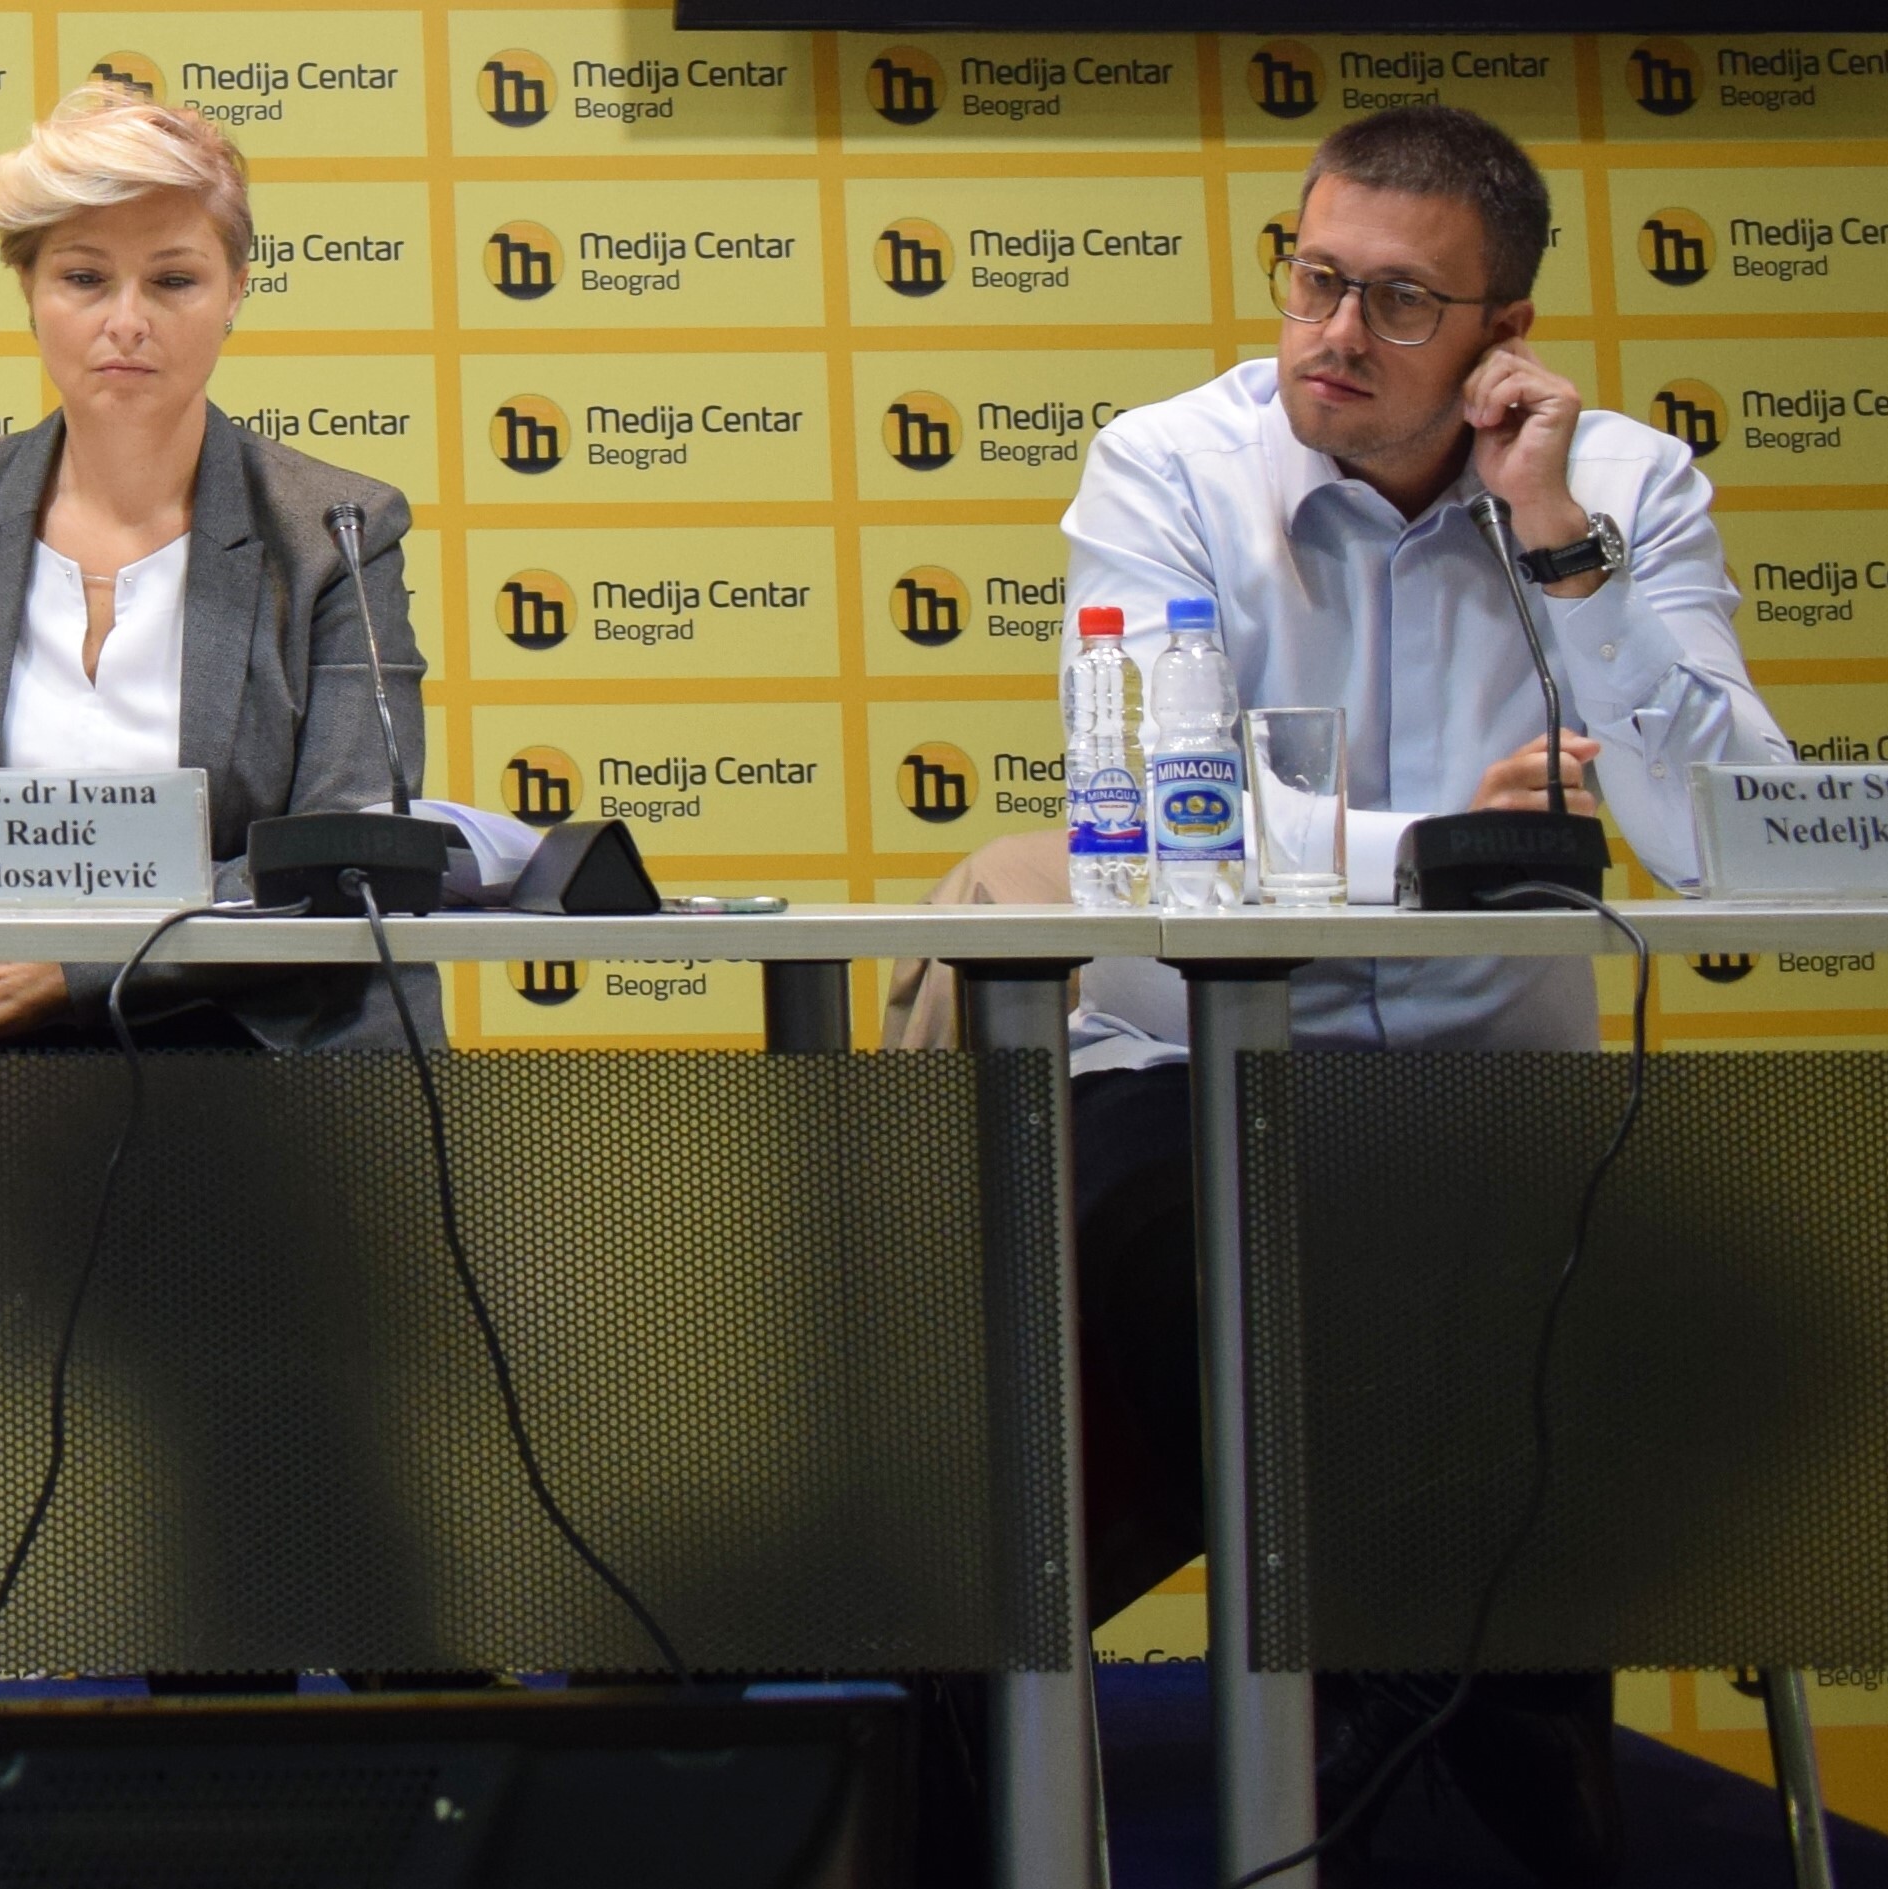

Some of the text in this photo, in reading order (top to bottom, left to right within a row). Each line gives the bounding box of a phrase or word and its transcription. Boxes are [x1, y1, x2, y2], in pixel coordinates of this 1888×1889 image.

[579, 231, 796, 266] Medija Centar
[581, 269, 681, 297] Beograd
[1158, 761, 1235, 782] MINAQUA
[21, 779, 57, 805] dr
[70, 779, 157, 805] Ivana
[1086, 789, 1139, 803] MINAQUA
[1734, 772, 1888, 802] Doc. dr S
[6, 819, 96, 846] Radić
